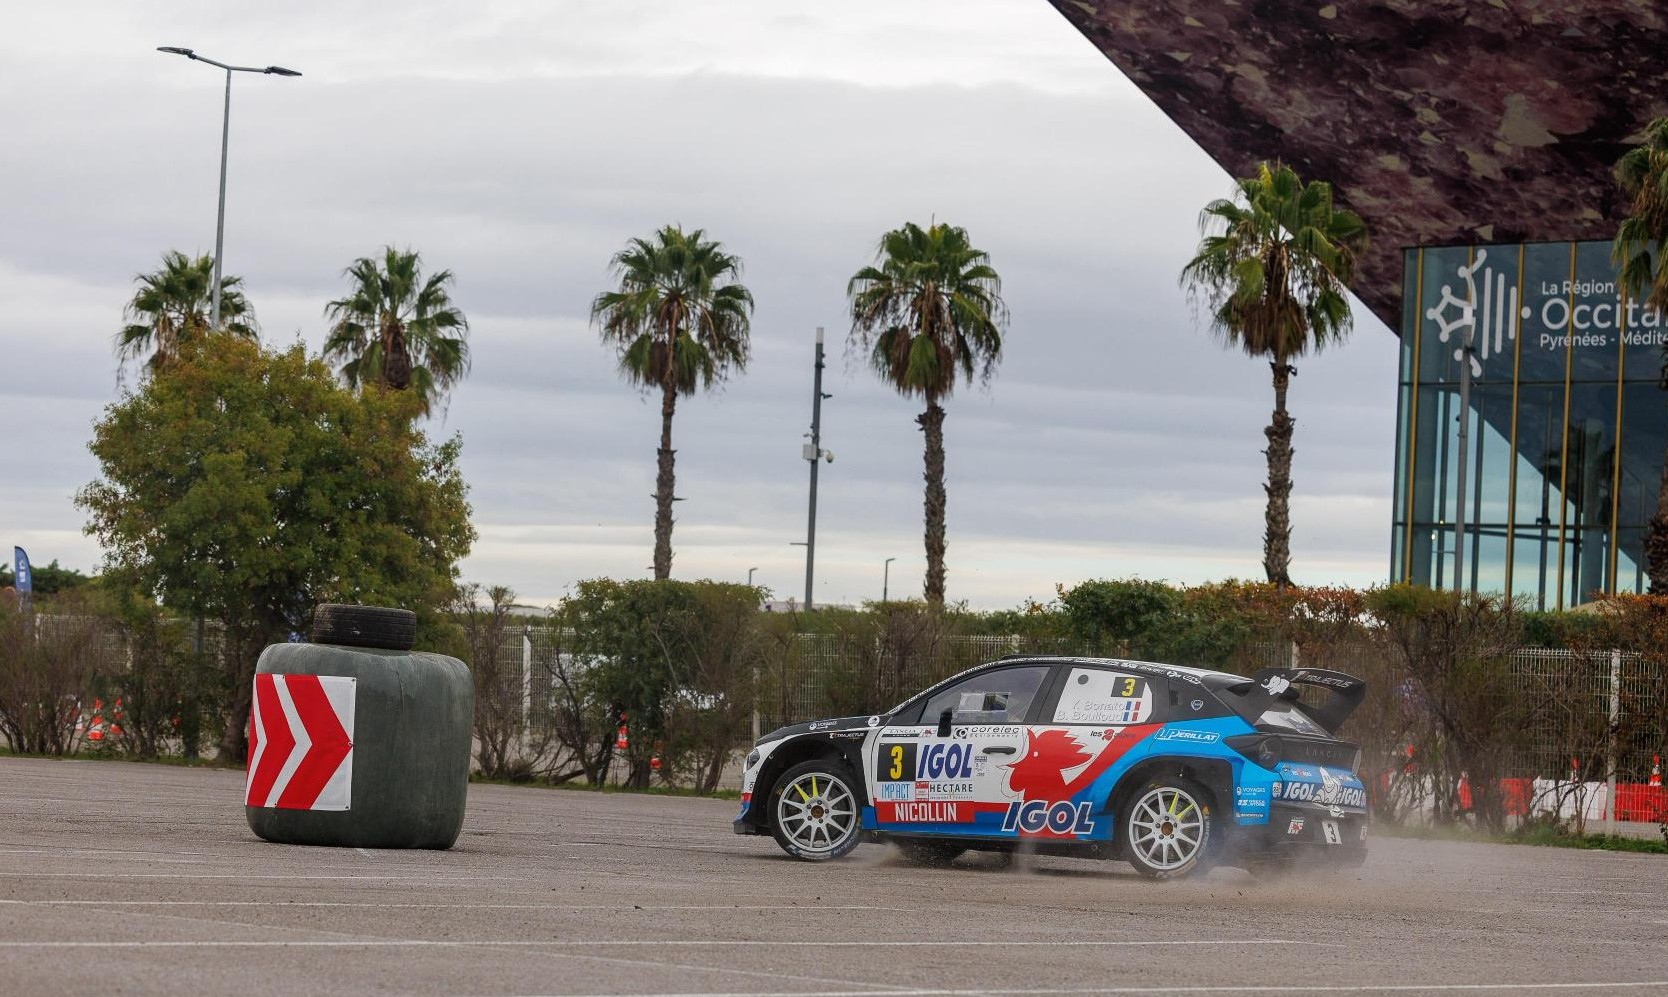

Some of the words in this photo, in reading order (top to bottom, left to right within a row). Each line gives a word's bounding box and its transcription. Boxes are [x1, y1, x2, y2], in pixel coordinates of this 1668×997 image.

[1542, 281, 1558, 295] La
[1563, 279, 1614, 297] Région
[1541, 294, 1668, 330] Occita
[1540, 332, 1607, 351] Pyrénées
[1121, 678, 1136, 697] 3
[971, 726, 1020, 734] corelec
[889, 745, 903, 780] 3
[917, 743, 974, 779] IGOL
[929, 783, 974, 793] HECTARE
[1283, 781, 1315, 801] IGOL
[1341, 787, 1363, 808] IGOL
[895, 802, 957, 822] NICOLLIN
[1001, 800, 1095, 834] IGOL
[1327, 823, 1337, 843] 3
